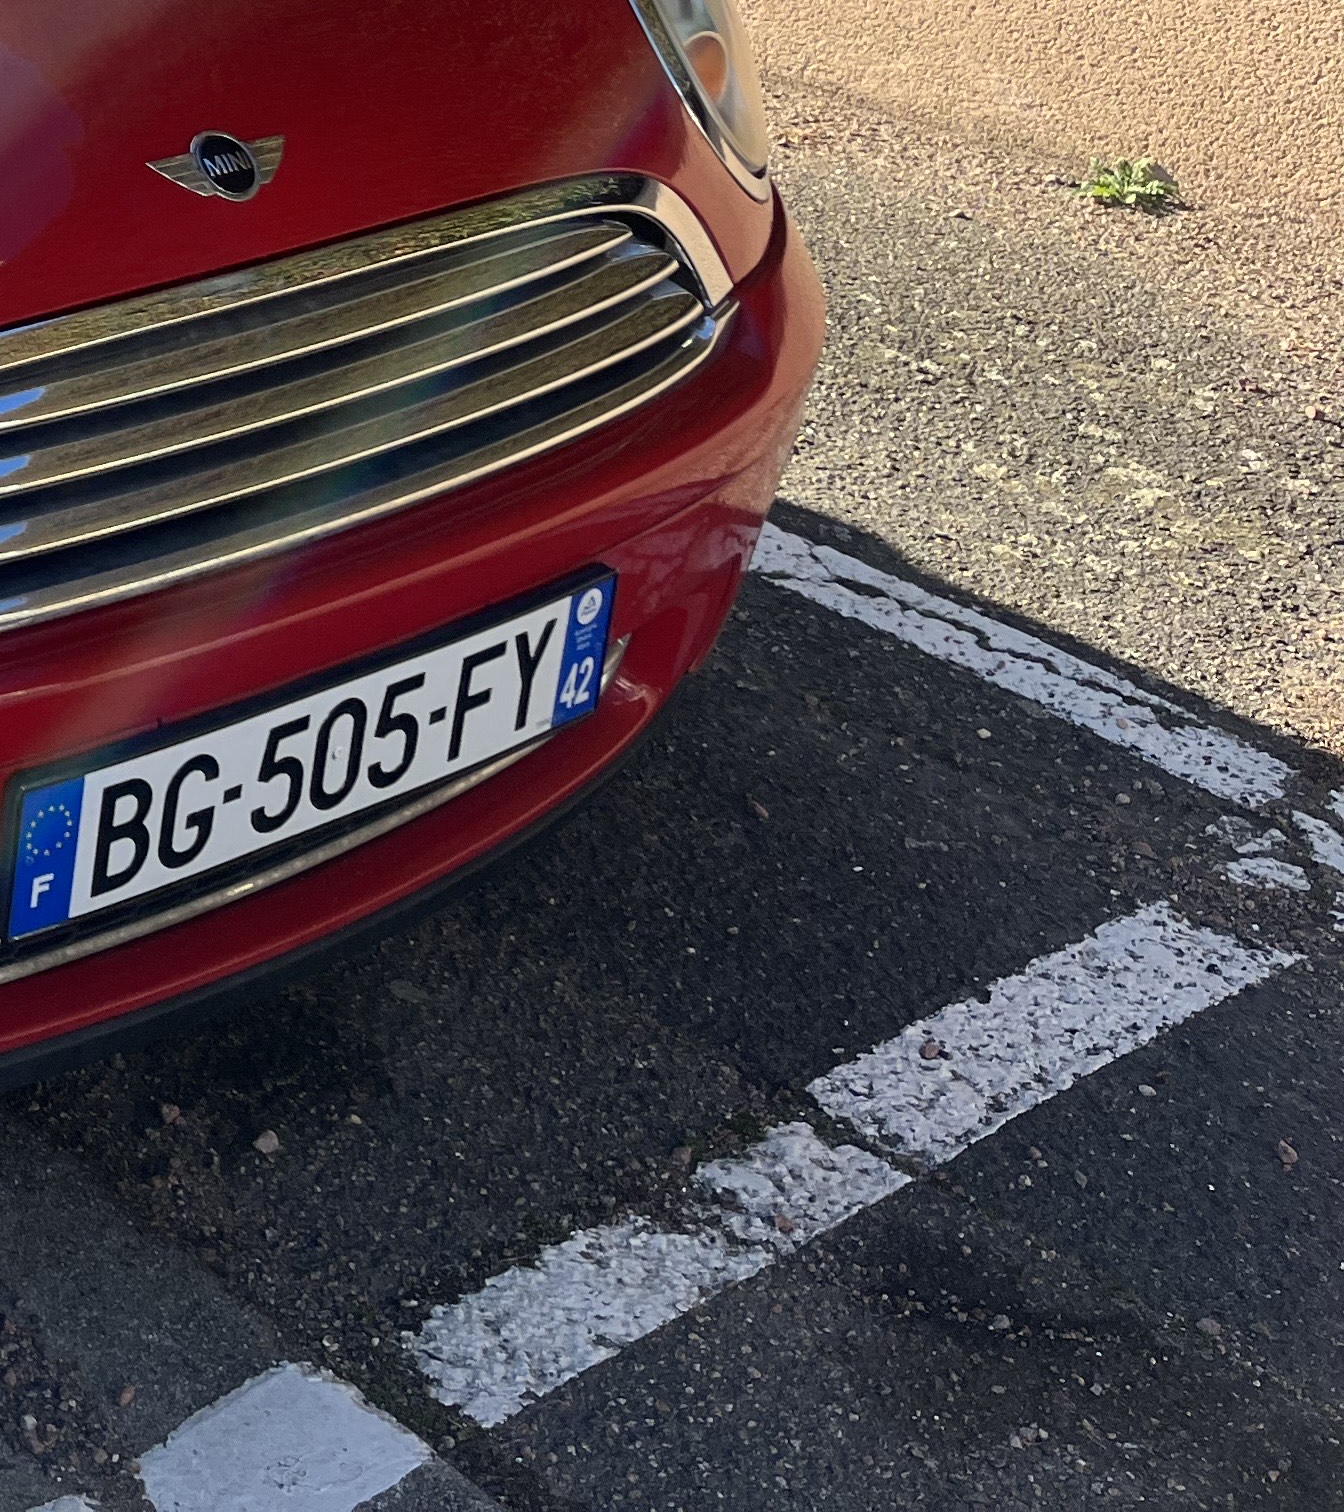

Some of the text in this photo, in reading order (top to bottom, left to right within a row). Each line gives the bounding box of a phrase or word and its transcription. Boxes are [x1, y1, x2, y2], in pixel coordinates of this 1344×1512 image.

[204, 150, 252, 177] MINI
[559, 656, 595, 709] 42
[90, 617, 558, 898] BG-505-FY
[29, 873, 55, 908] F
